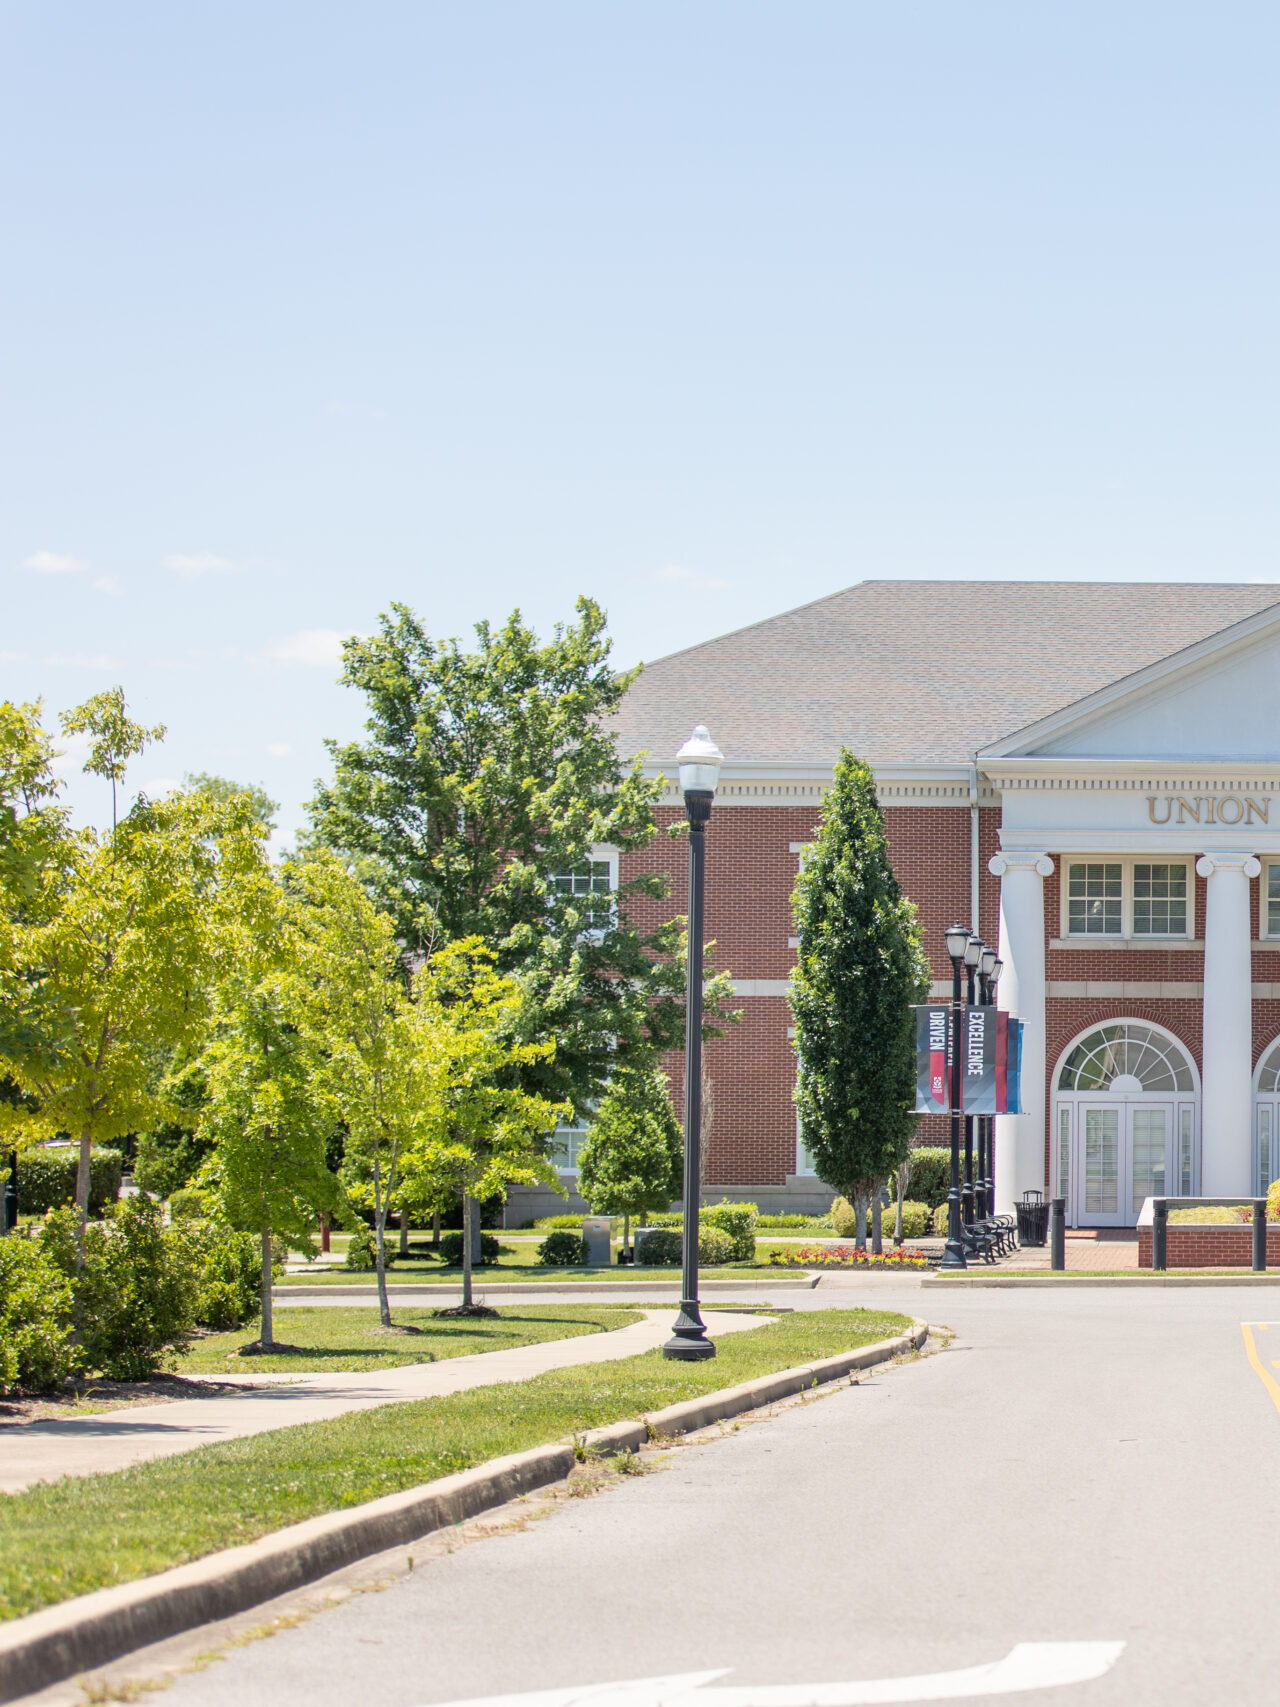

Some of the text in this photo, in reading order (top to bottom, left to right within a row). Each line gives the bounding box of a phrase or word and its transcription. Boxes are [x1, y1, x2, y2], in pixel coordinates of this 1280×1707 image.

[1146, 797, 1271, 825] UNION
[929, 1011, 945, 1050] DRIVEN
[968, 1012, 984, 1075] EXCELLENCE
